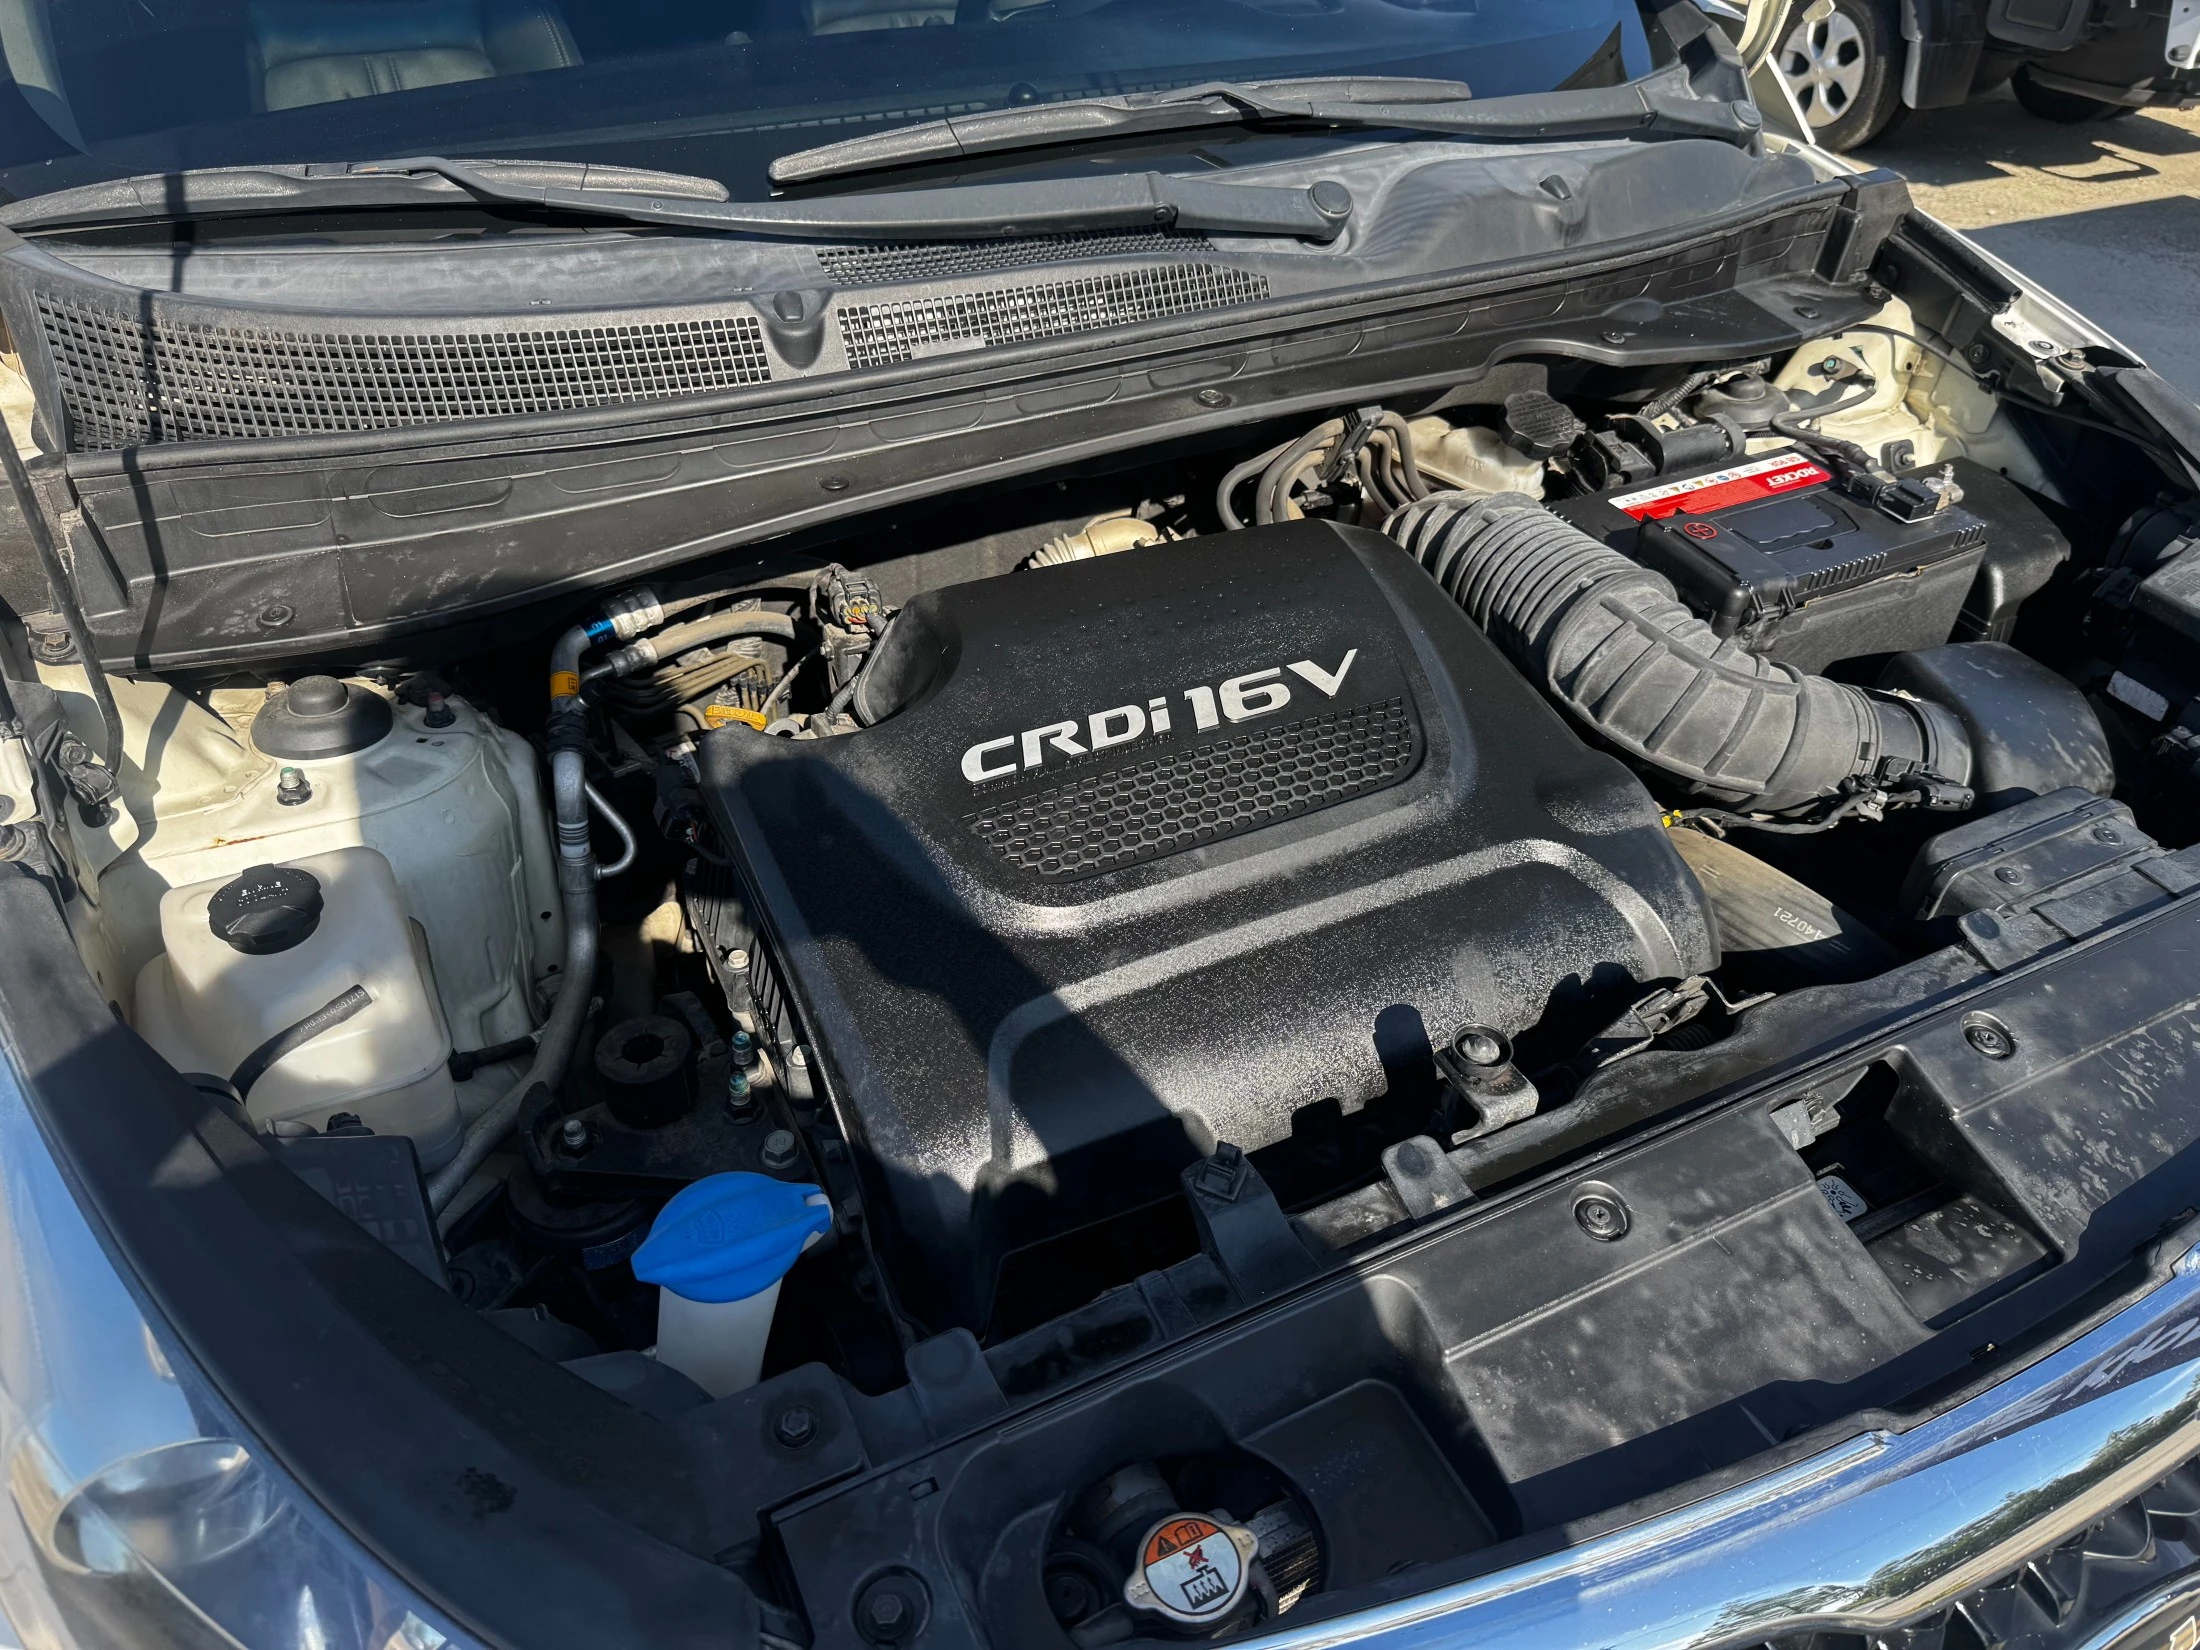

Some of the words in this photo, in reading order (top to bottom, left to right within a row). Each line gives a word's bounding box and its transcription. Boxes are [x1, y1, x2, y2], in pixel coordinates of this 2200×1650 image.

[1766, 466, 1820, 487] ROCKET
[961, 696, 1171, 784] CRDi
[1184, 648, 1358, 734] 16V
